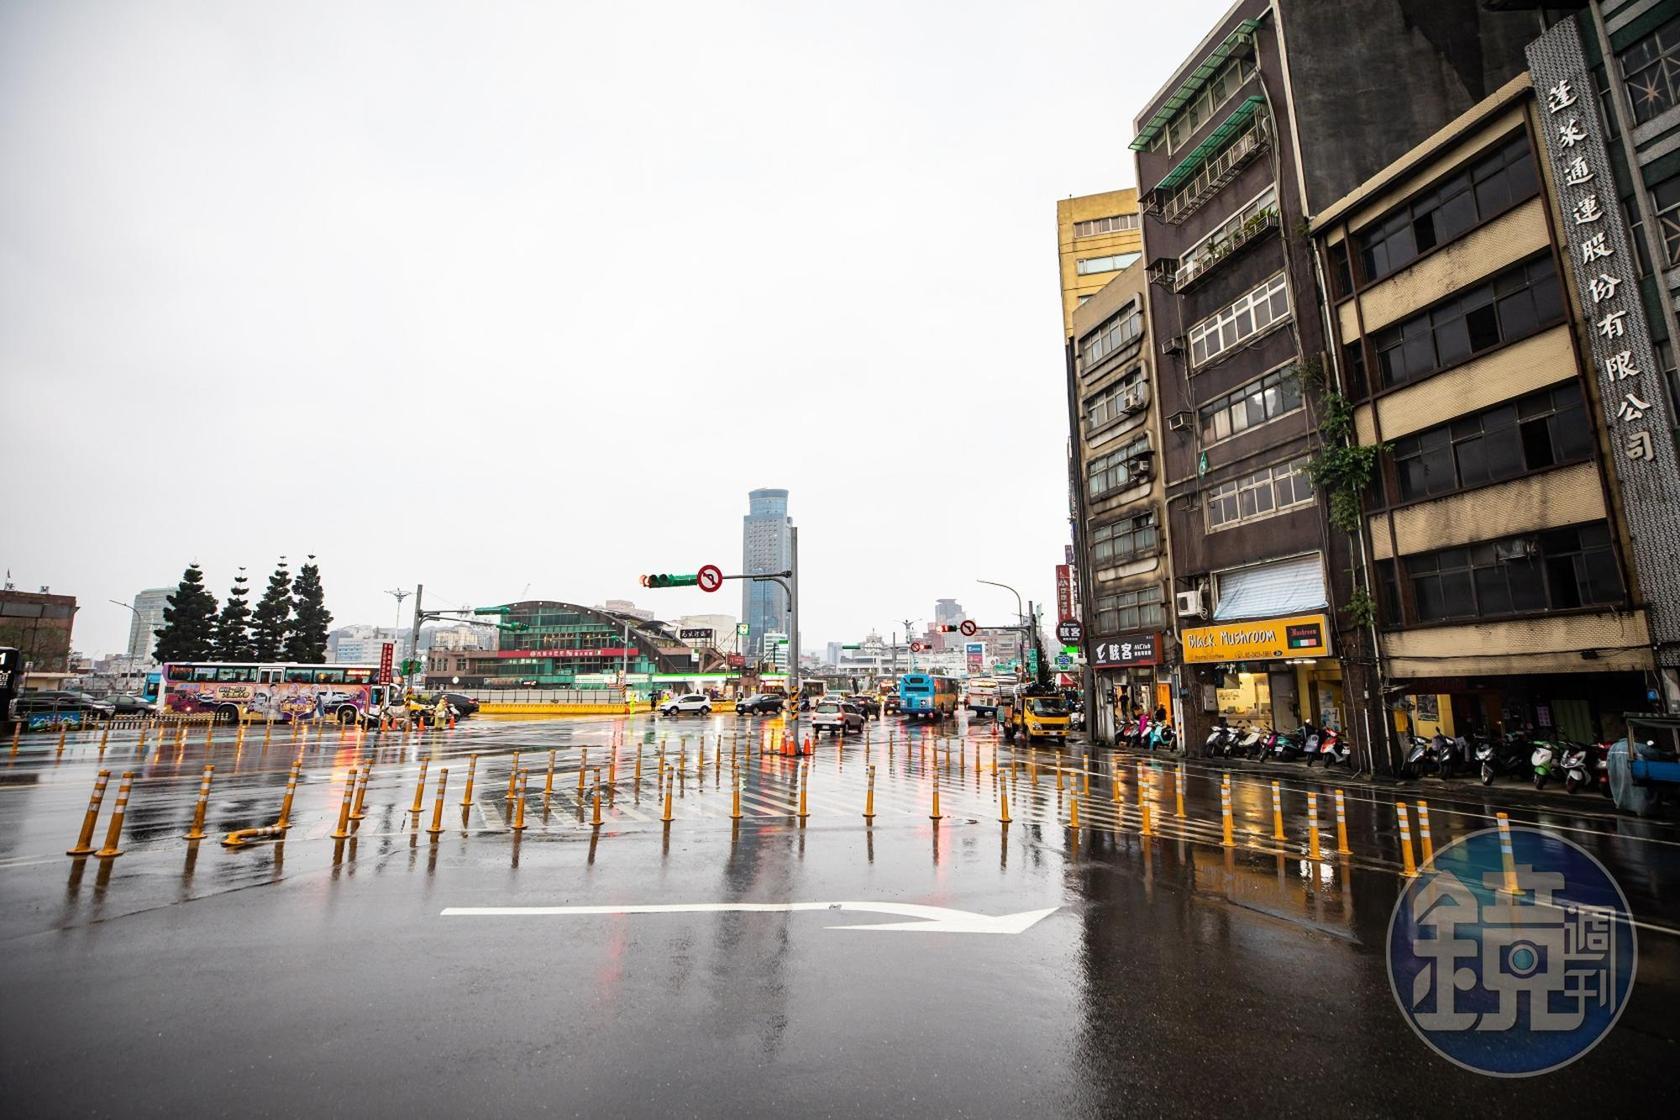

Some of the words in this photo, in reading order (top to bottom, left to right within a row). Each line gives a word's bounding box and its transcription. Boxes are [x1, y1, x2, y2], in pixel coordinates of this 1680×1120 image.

[1548, 79, 1655, 462] 蓬萊通運股份有限公司
[1188, 633, 1216, 649] Black
[1219, 629, 1276, 646] Mushroom
[1109, 643, 1132, 660] 駭客
